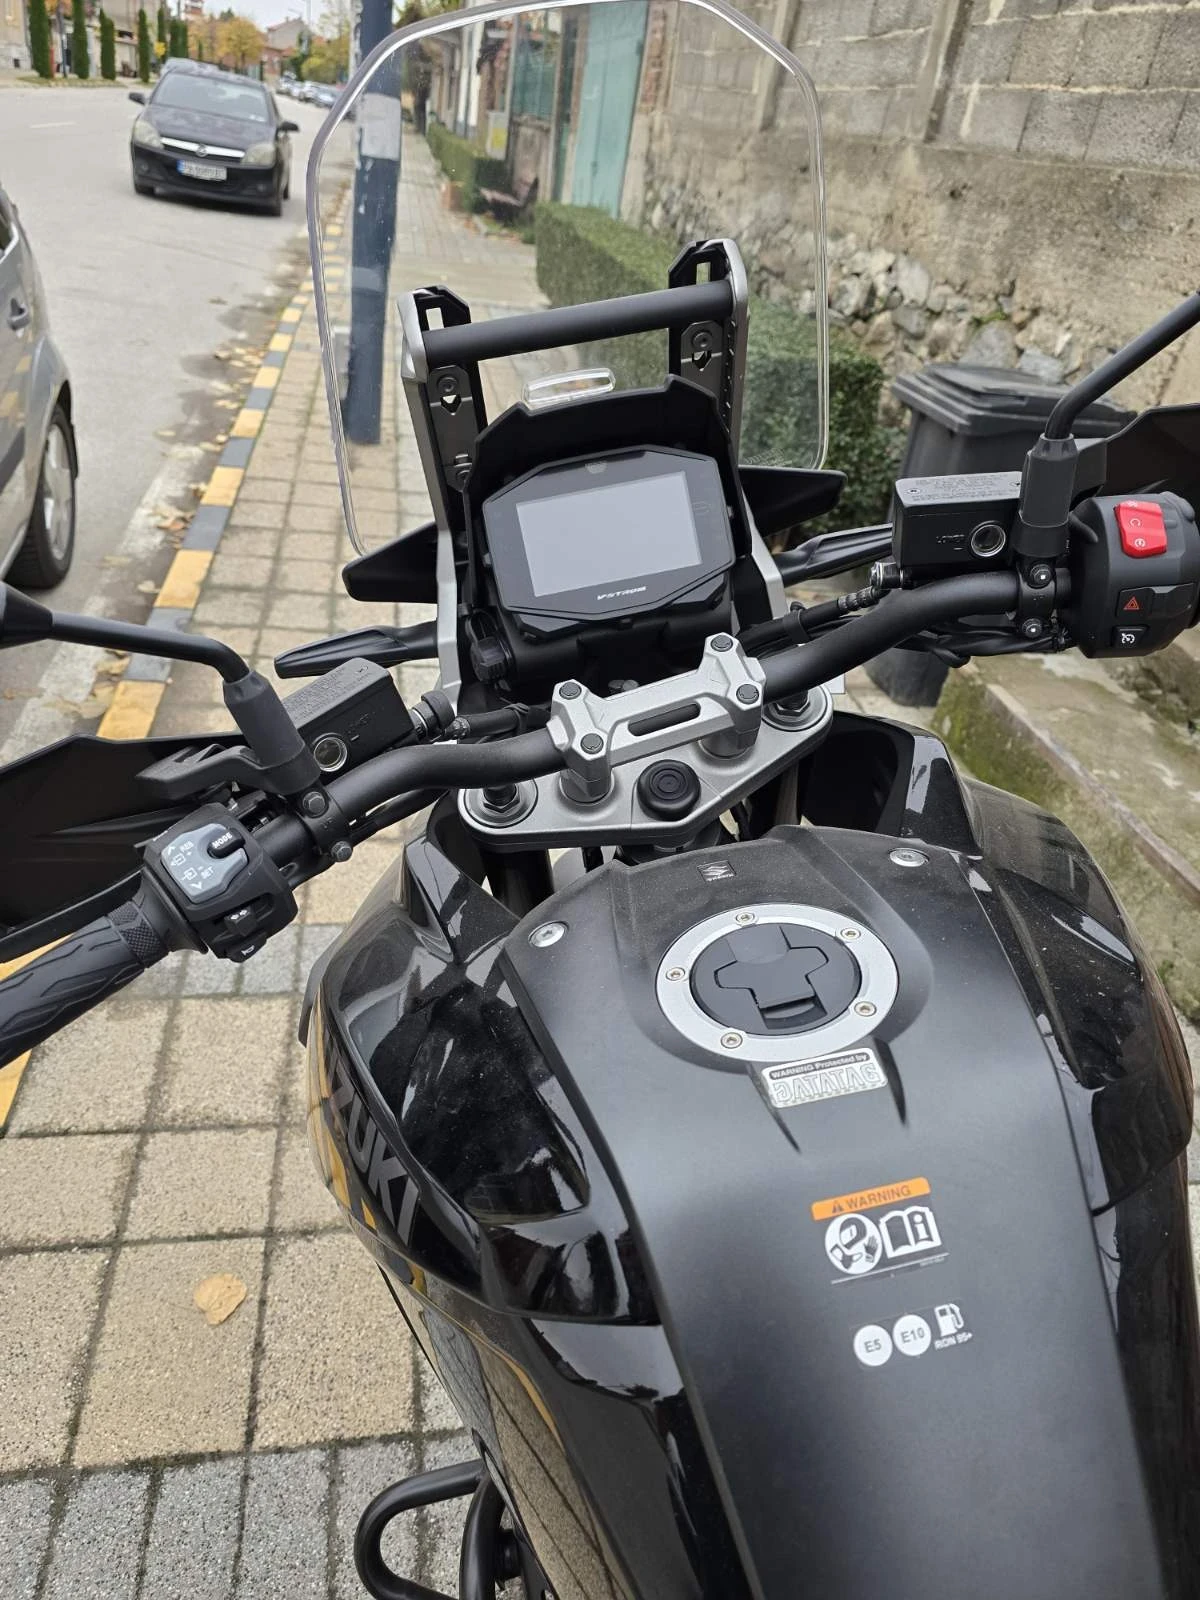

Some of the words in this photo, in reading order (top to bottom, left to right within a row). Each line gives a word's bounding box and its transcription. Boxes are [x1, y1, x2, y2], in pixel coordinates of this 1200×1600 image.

[211, 832, 233, 849] MODE
[771, 1064, 815, 1079] WARNING
[815, 1055, 855, 1070] Protected
[855, 1053, 868, 1062] by
[846, 1185, 912, 1210] WARNING
[900, 1327, 925, 1344] E10
[864, 1338, 882, 1353] E5
